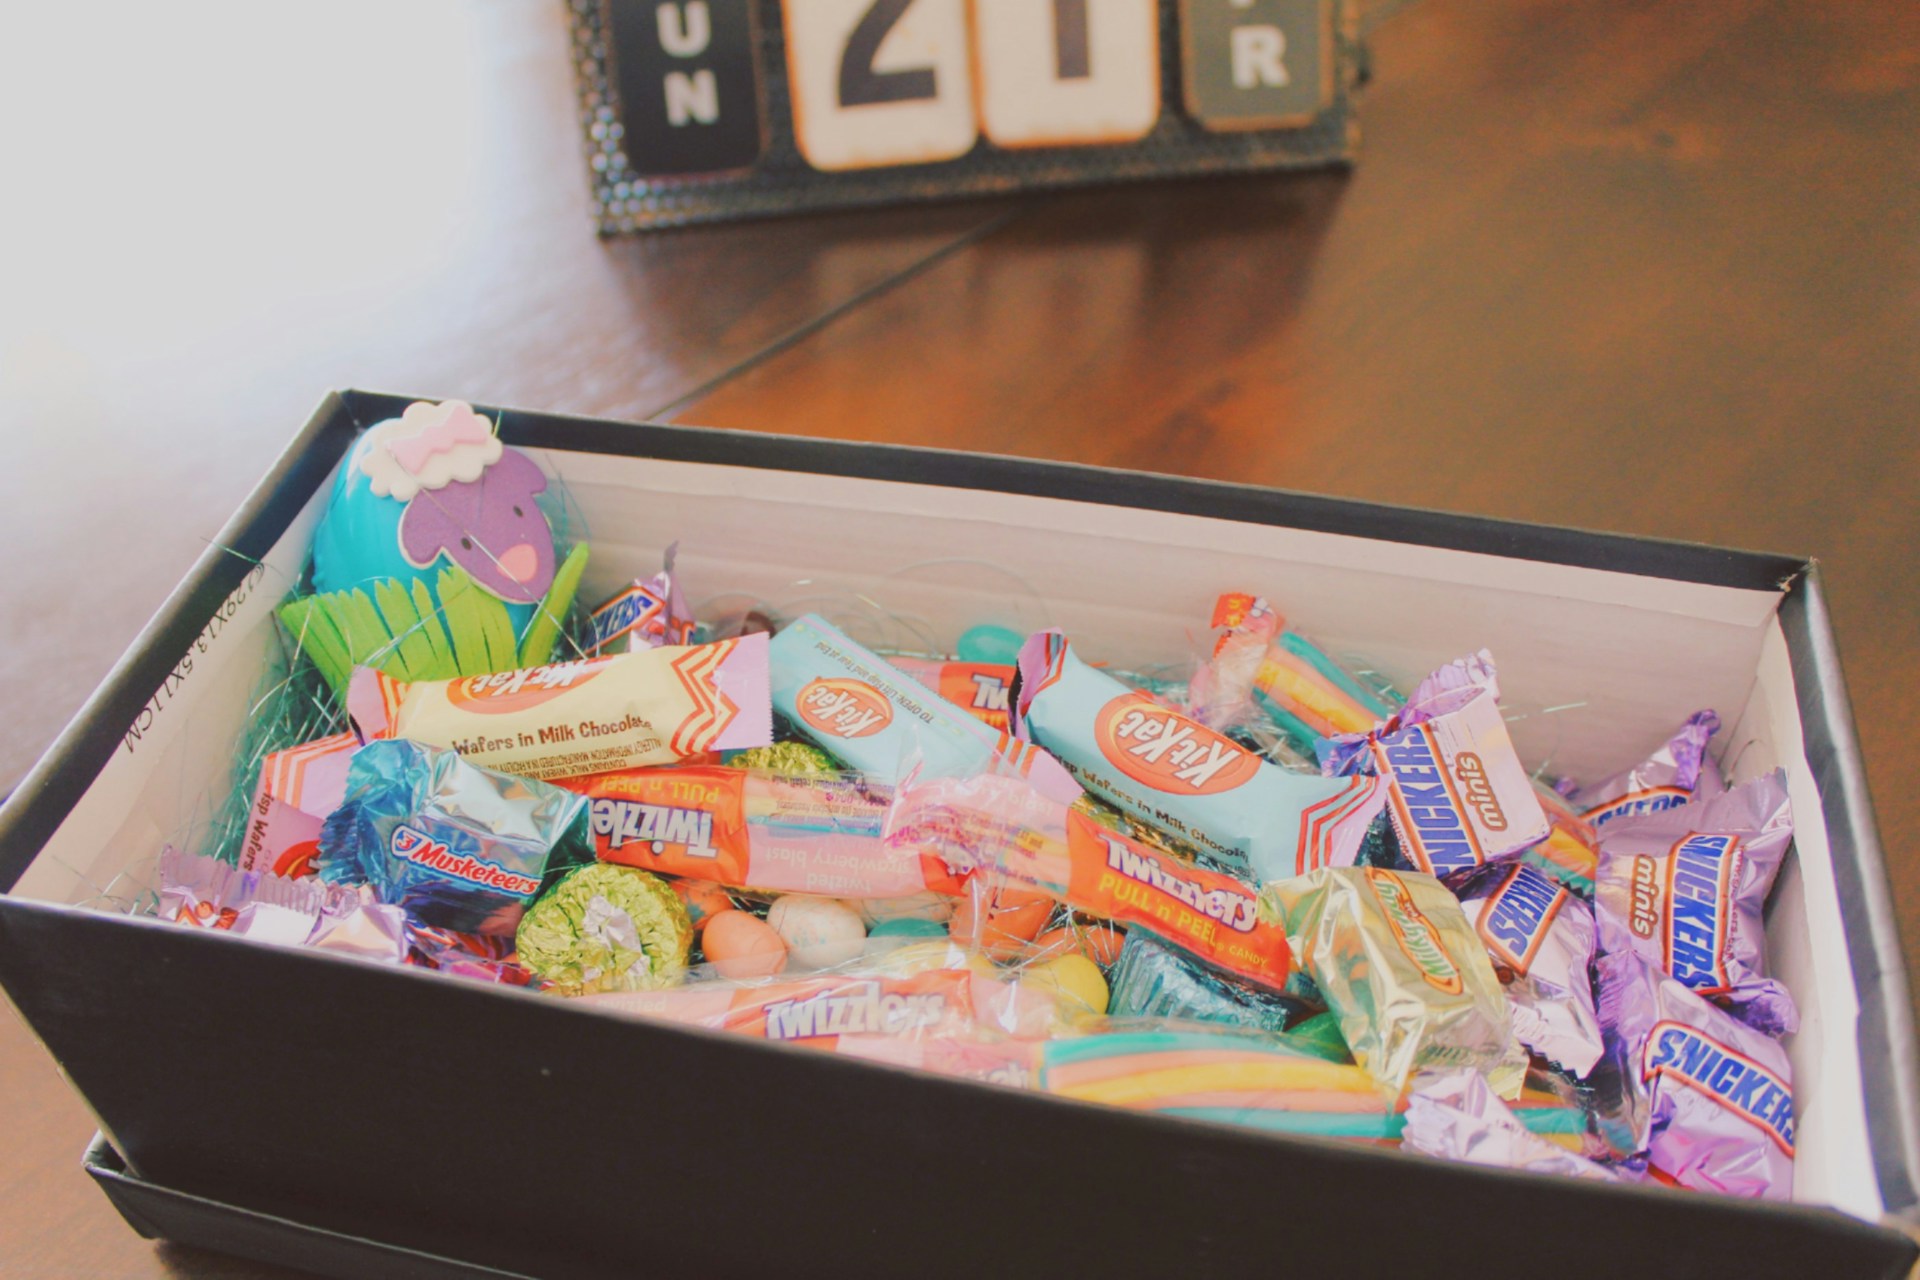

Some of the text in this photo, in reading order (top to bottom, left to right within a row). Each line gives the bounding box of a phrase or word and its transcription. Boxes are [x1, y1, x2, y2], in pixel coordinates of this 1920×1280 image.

[451, 735, 514, 756] Wafers
[517, 732, 535, 748] in
[537, 725, 575, 745] Milk
[1137, 800, 1152, 814] in
[1154, 807, 1188, 834] Milk
[1458, 754, 1505, 831] minis
[242, 818, 270, 872] Wafers
[400, 831, 539, 896] 3 Musketeers
[1098, 872, 1151, 913] PULL
[1228, 944, 1270, 968] CANDY
[1633, 857, 1659, 937] minis
[1671, 834, 1730, 990] SNICKERS
[764, 979, 946, 1041] Twizzlers
